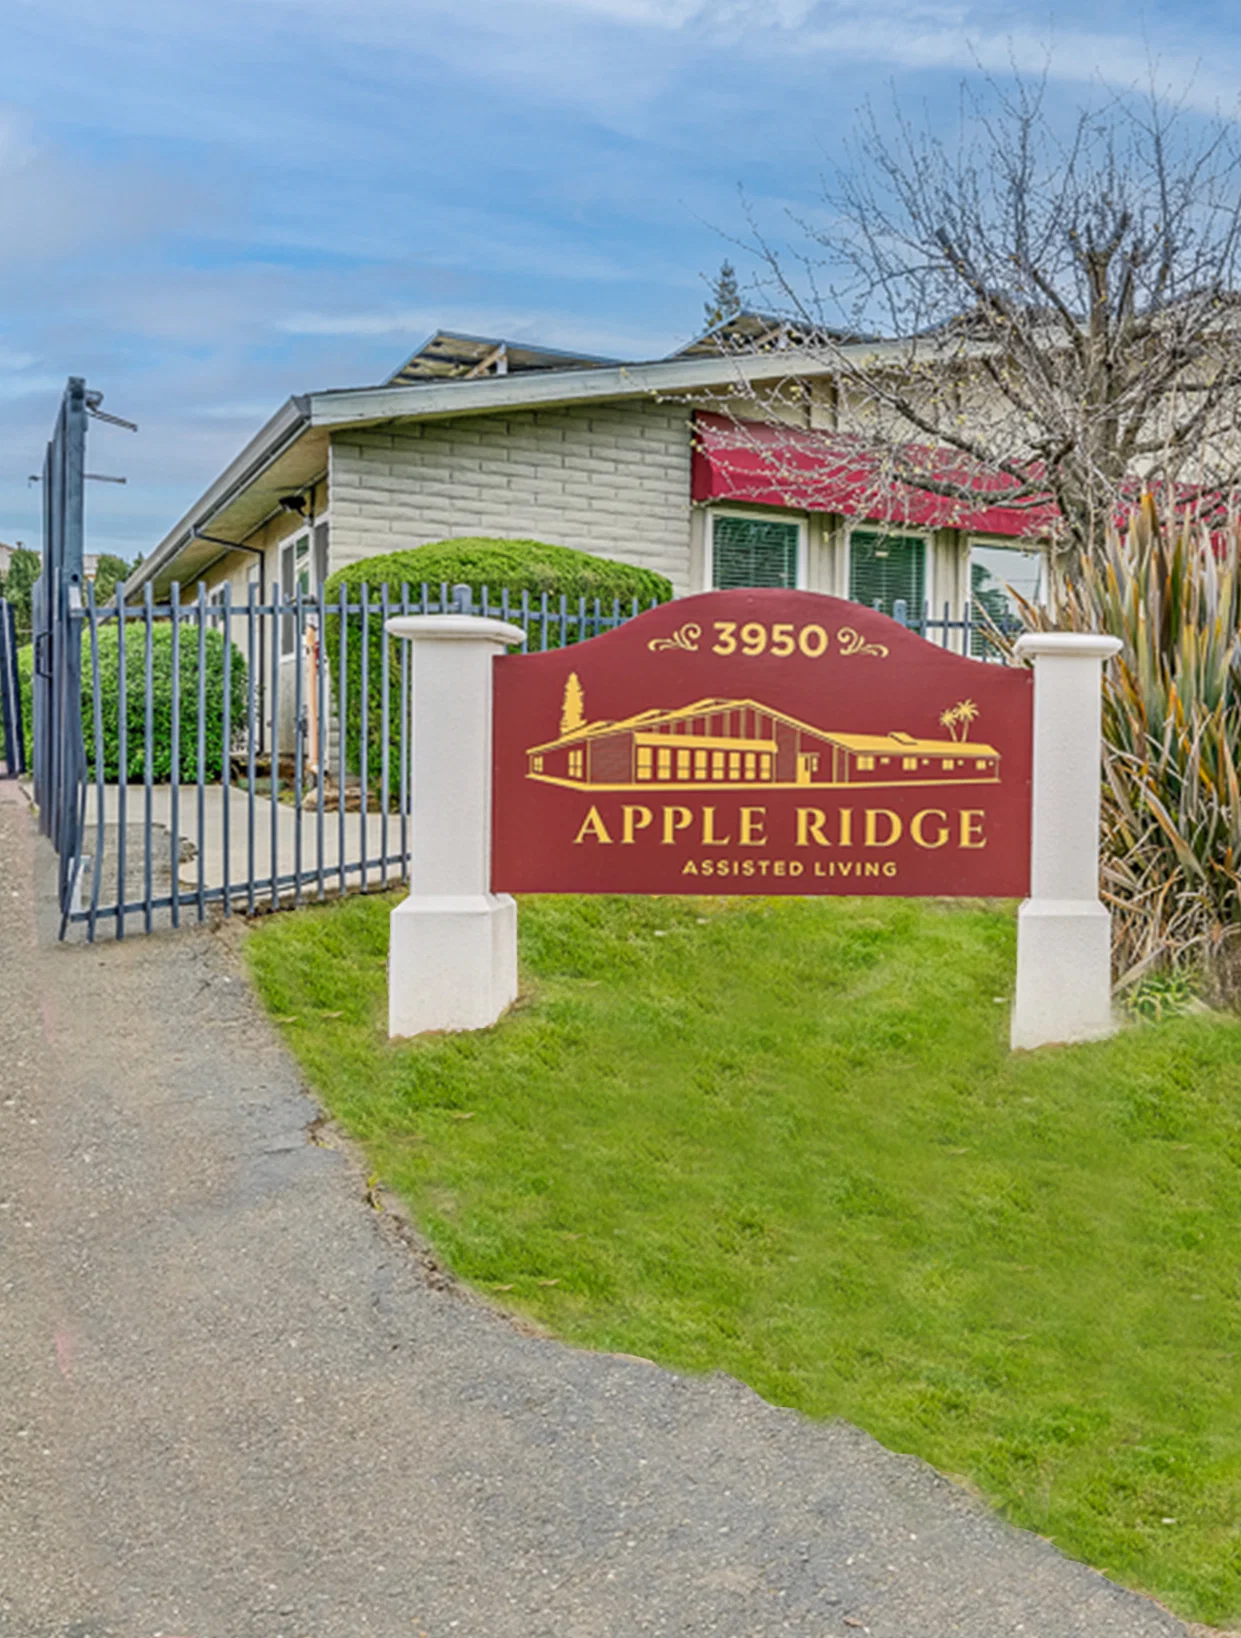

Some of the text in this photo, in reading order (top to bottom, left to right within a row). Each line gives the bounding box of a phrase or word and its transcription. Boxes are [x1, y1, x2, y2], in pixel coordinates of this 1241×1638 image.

[712, 621, 829, 658] 3950
[573, 804, 988, 849] APPLE RIDGE
[681, 859, 898, 878] ASSISTED LIVING
